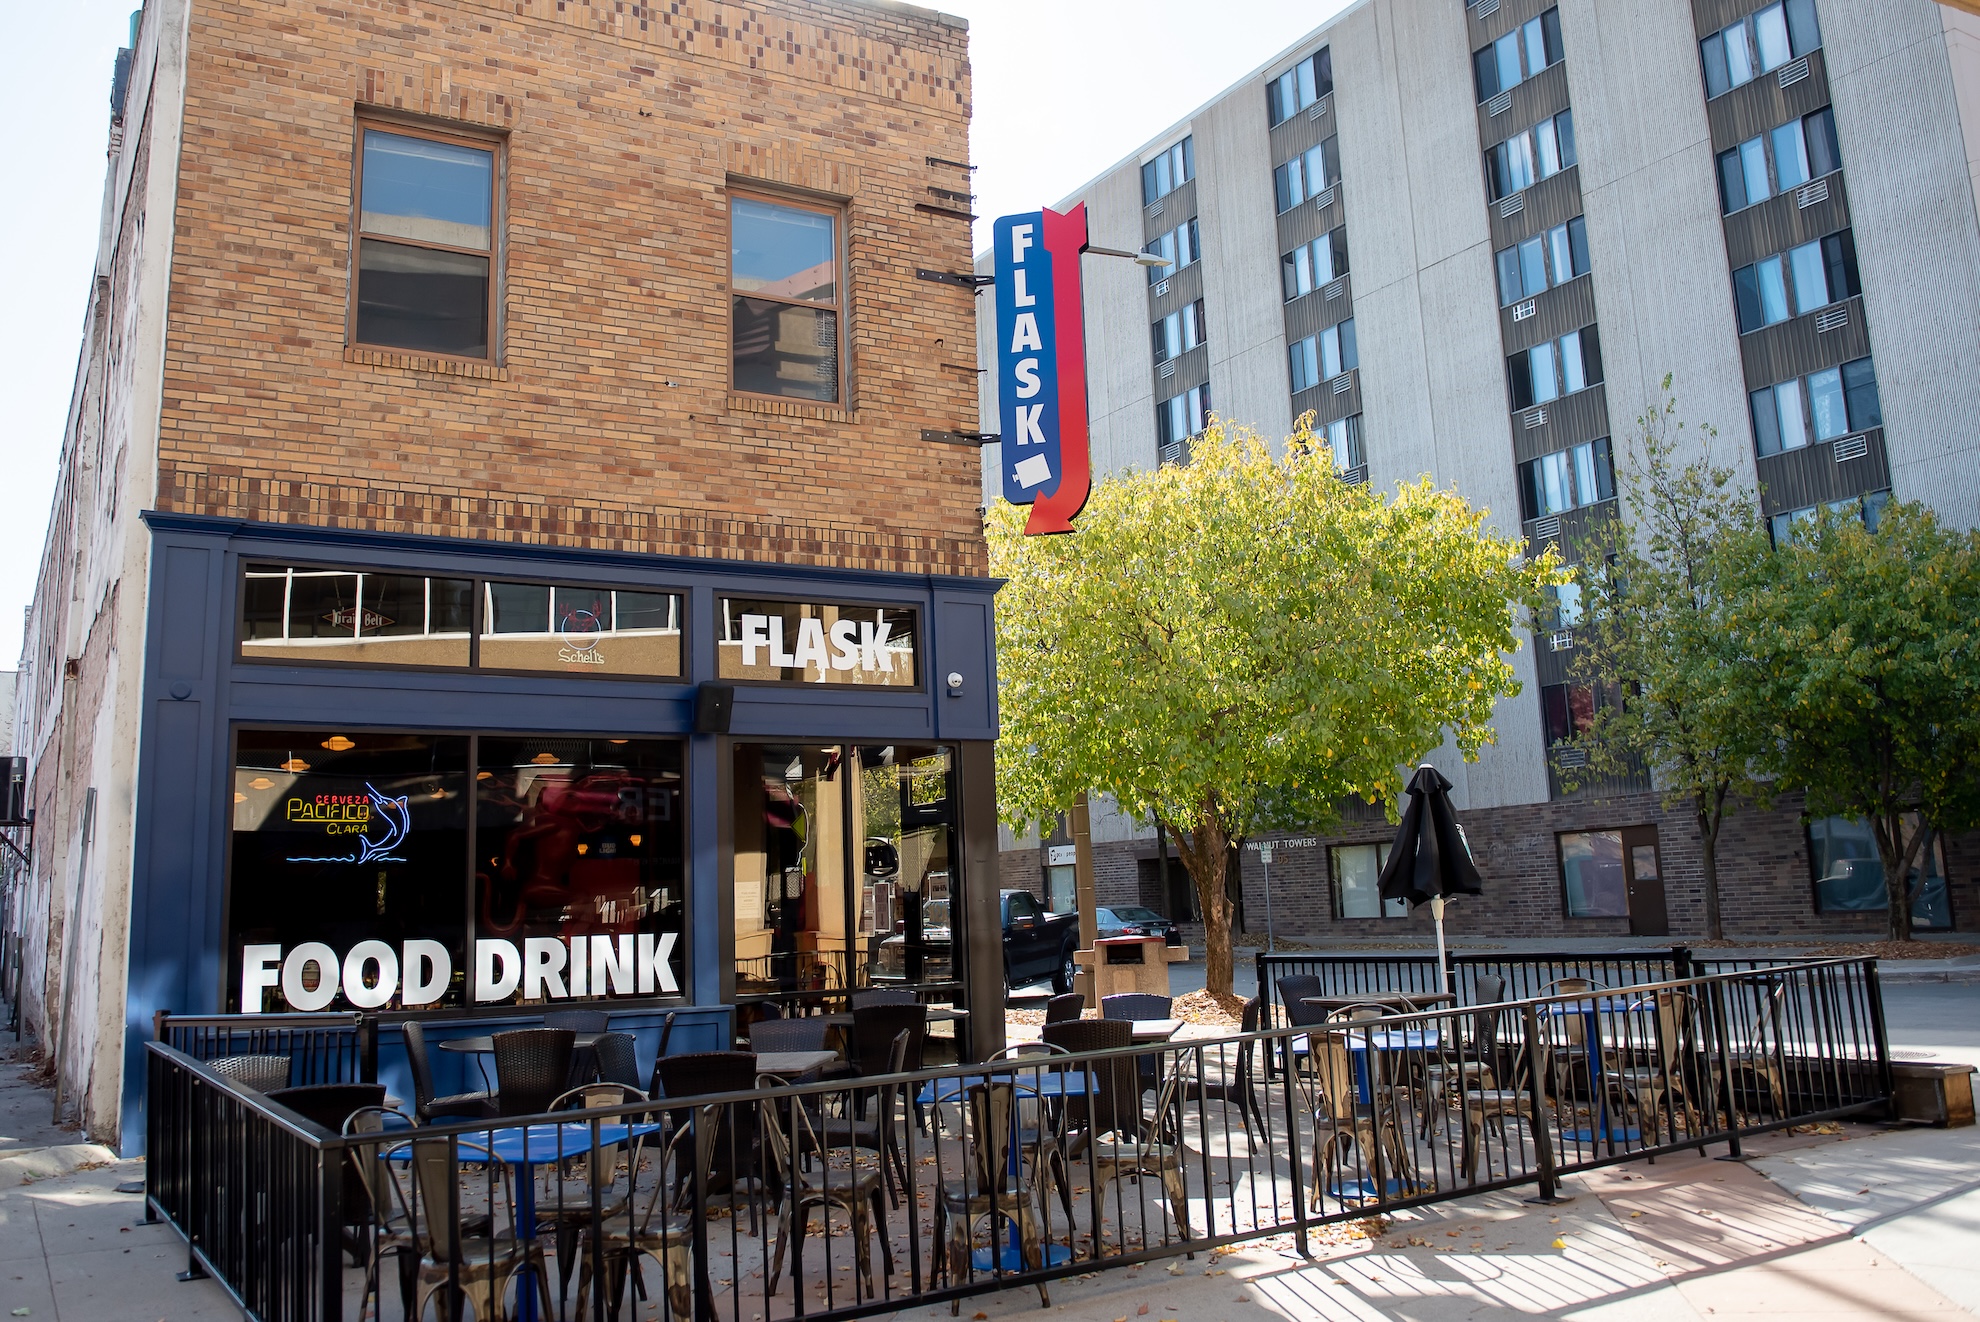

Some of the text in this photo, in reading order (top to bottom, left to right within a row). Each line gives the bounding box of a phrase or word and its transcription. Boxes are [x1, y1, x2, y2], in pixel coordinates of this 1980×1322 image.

[1011, 223, 1047, 445] FLASK
[332, 607, 383, 627] Grai Belt
[741, 614, 894, 672] FLASK
[558, 647, 605, 664] Schell's
[315, 795, 370, 805] CERVEZA
[326, 823, 368, 835] CLARA
[1283, 838, 1317, 849] TOWERS
[241, 932, 680, 1013] FOOD DRINK
